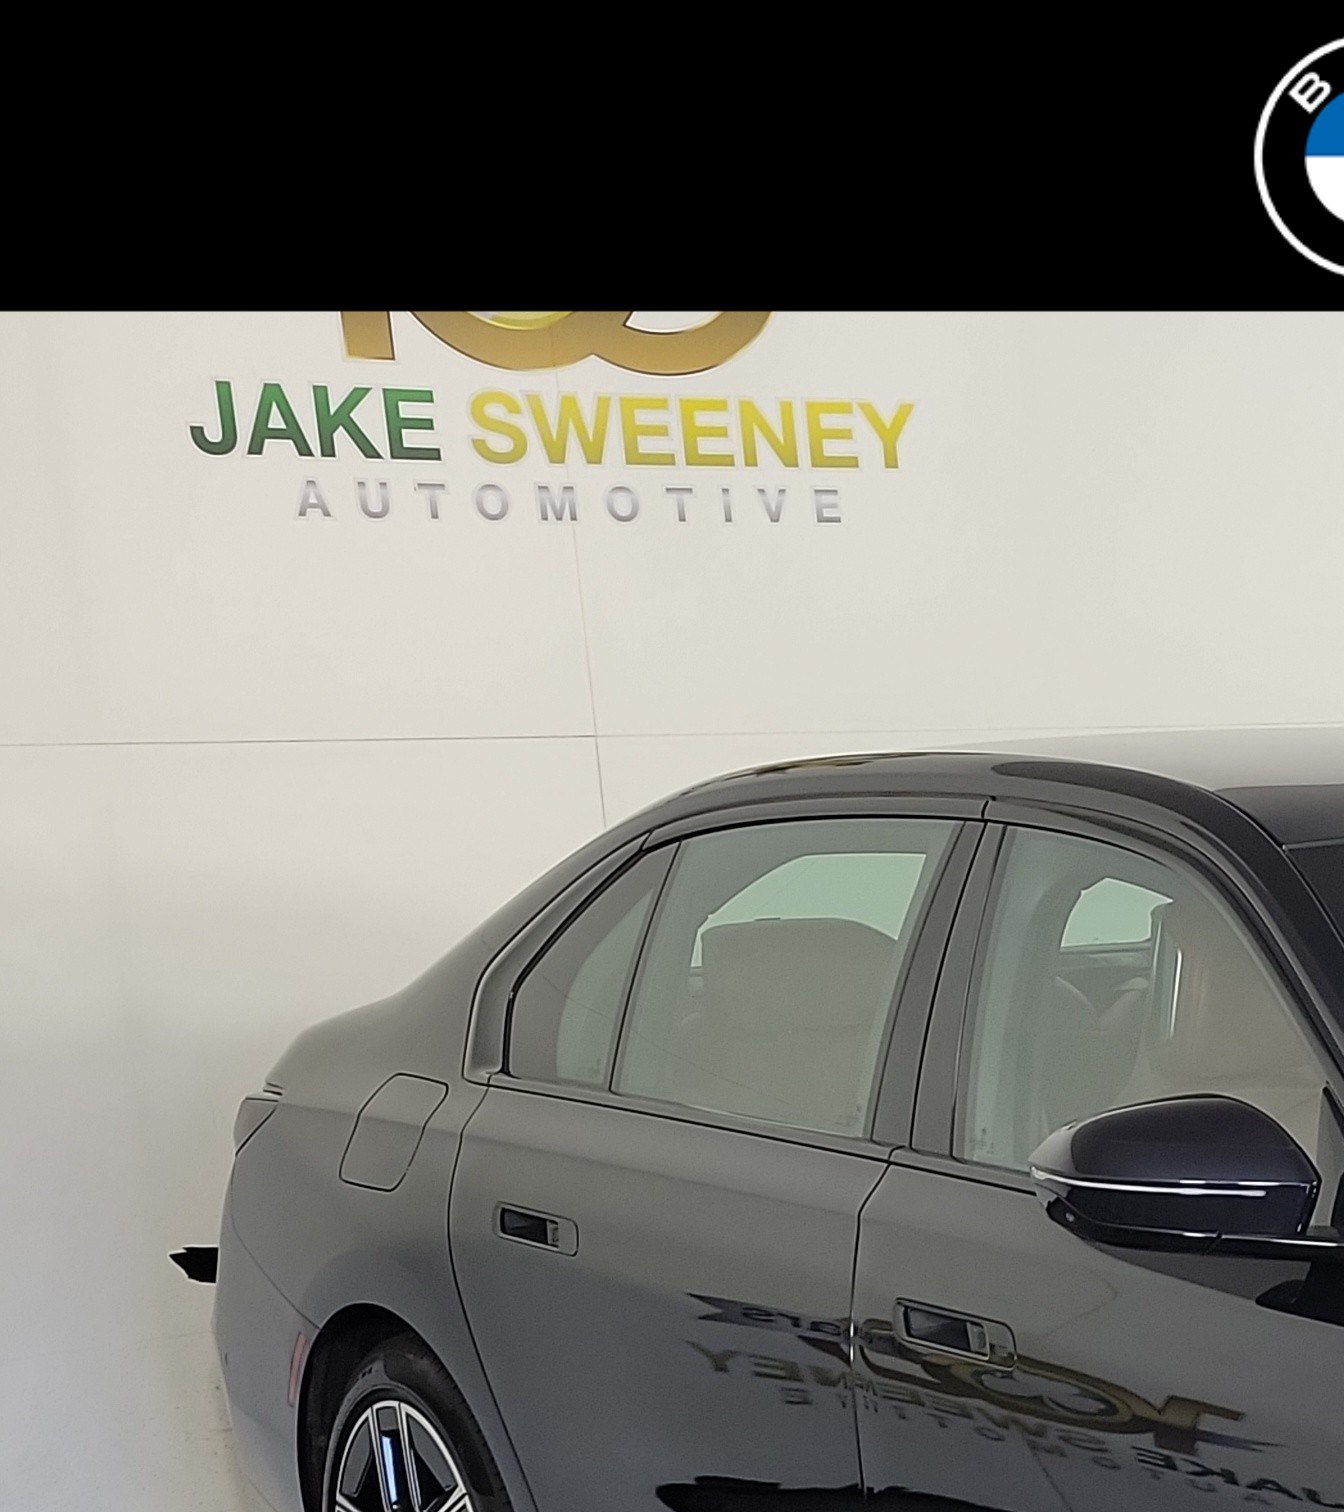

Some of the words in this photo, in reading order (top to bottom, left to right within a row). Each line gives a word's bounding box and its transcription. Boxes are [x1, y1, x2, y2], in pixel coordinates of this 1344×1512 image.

[190, 379, 442, 461] JAKE
[470, 390, 914, 468] SWEENEY
[297, 480, 843, 524] AUTOMOTIVE
